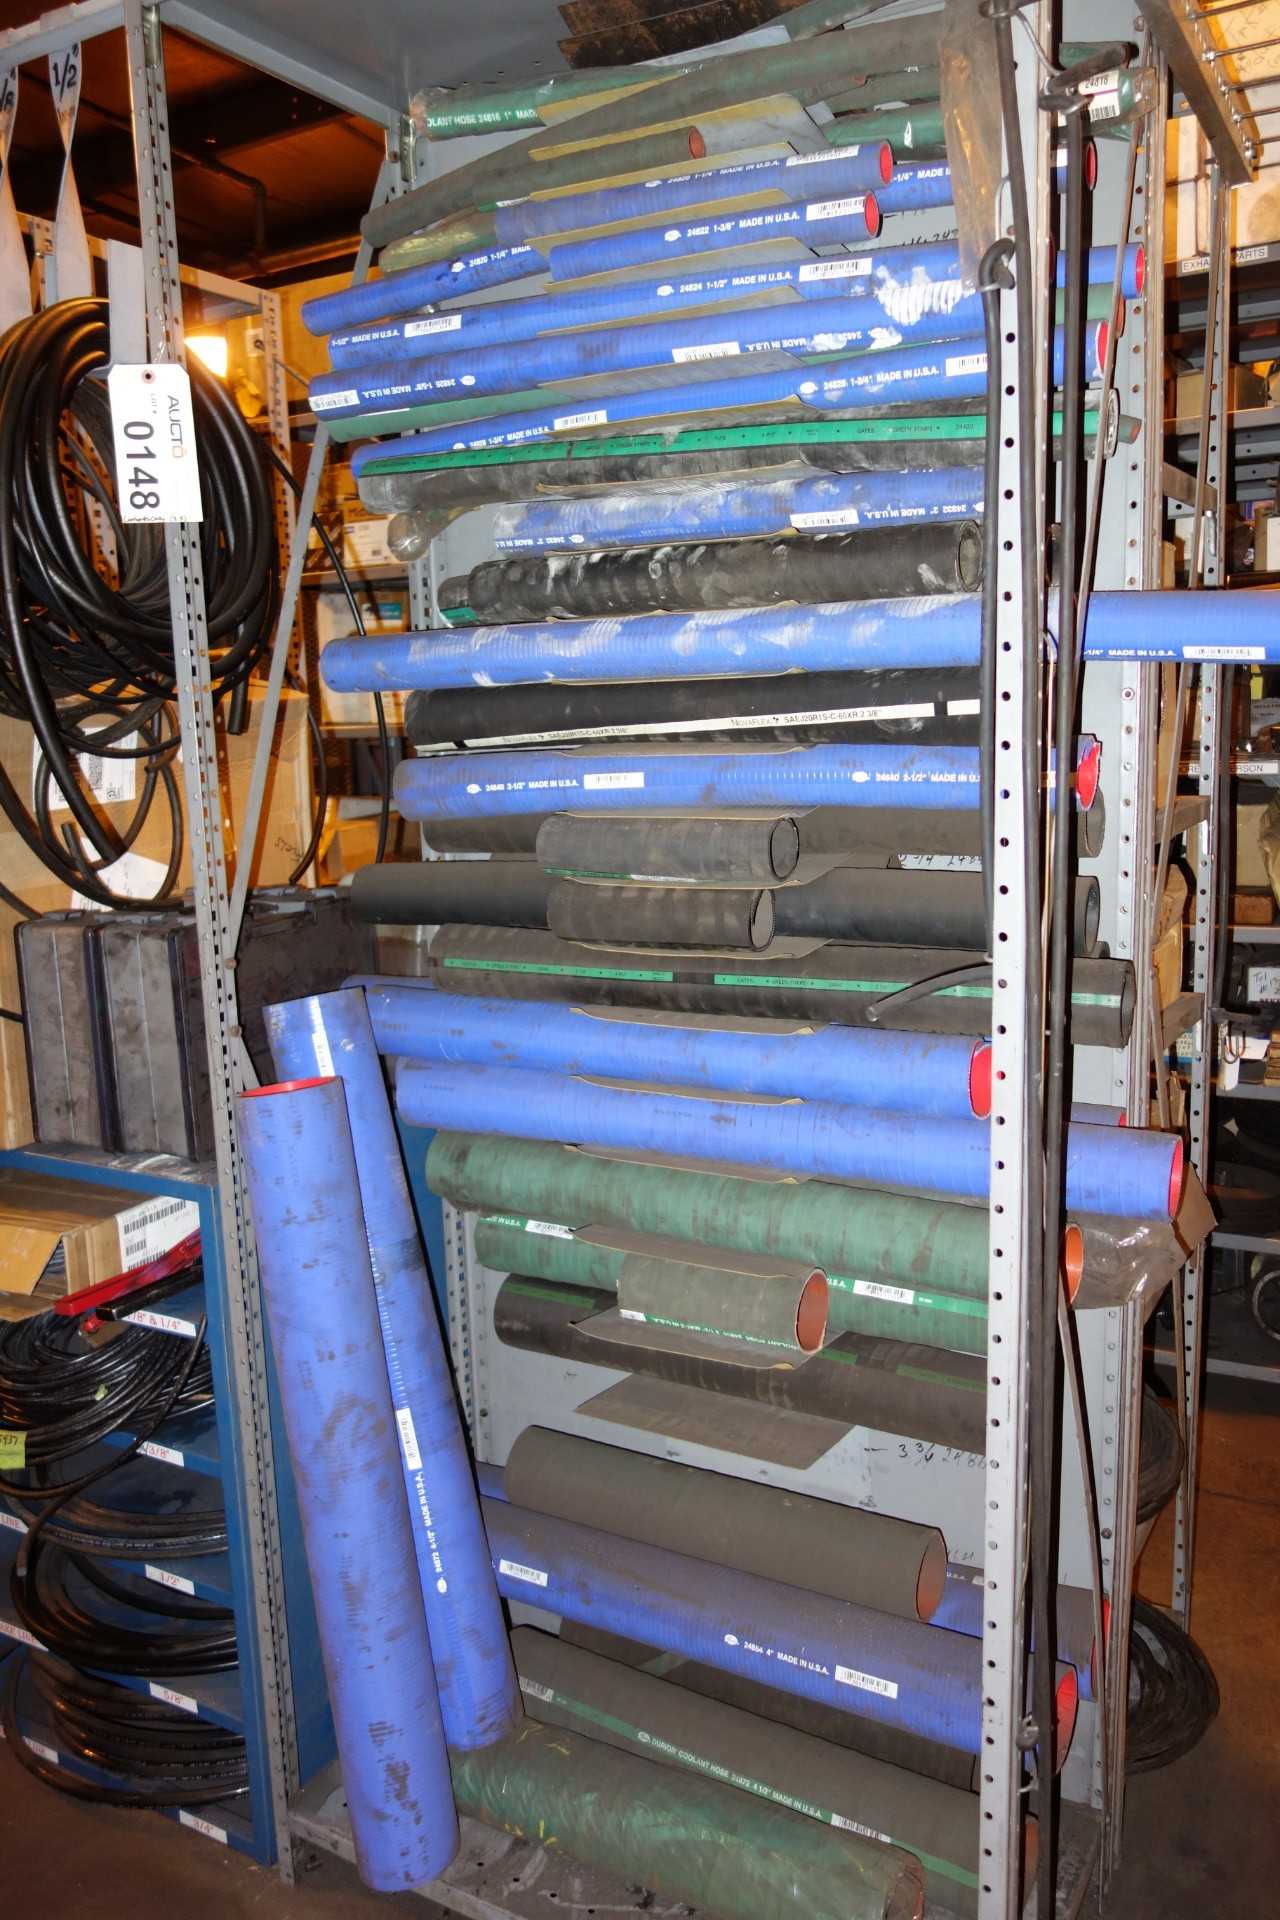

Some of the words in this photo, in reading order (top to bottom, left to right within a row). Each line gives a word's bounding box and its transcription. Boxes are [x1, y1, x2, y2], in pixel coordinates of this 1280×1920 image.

[720, 165, 744, 175] MADE
[745, 164, 755, 172] IN
[917, 167, 944, 179] MADE
[739, 217, 763, 229] MADE
[765, 216, 774, 225] IN
[775, 210, 800, 222] U.S.A.
[732, 275, 756, 286] MADE
[757, 274, 767, 283] IN
[768, 270, 792, 281] U.S.A.
[352, 335, 371, 343] MADE
[781, 337, 807, 348] MADE
[771, 341, 780, 349] IN
[877, 371, 901, 383] MADE
[903, 369, 912, 379] IN
[914, 365, 940, 378] U.S.A.
[507, 432, 525, 441] MADE
[525, 429, 532, 437] IN
[124, 420, 161, 511] 0148
[890, 509, 900, 518] IN
[901, 508, 926, 519] MADE
[1109, 649, 1135, 657] MADE
[1137, 649, 1148, 657] IN
[1149, 649, 1177, 657] U.S.A.
[931, 773, 957, 783] MADE
[958, 773, 968, 783] IN
[528, 780, 549, 789] MADE
[549, 780, 557, 788] IN
[421, 1503, 432, 1528] MADE
[777, 1651, 798, 1665] MADE
[799, 1658, 807, 1668] IN
[808, 1661, 830, 1676] U.S.A.
[678, 1750, 710, 1769] COOLANT
[710, 1762, 729, 1778] HOSE
[772, 1790, 793, 1806] MADE
[794, 1800, 802, 1811] IN
